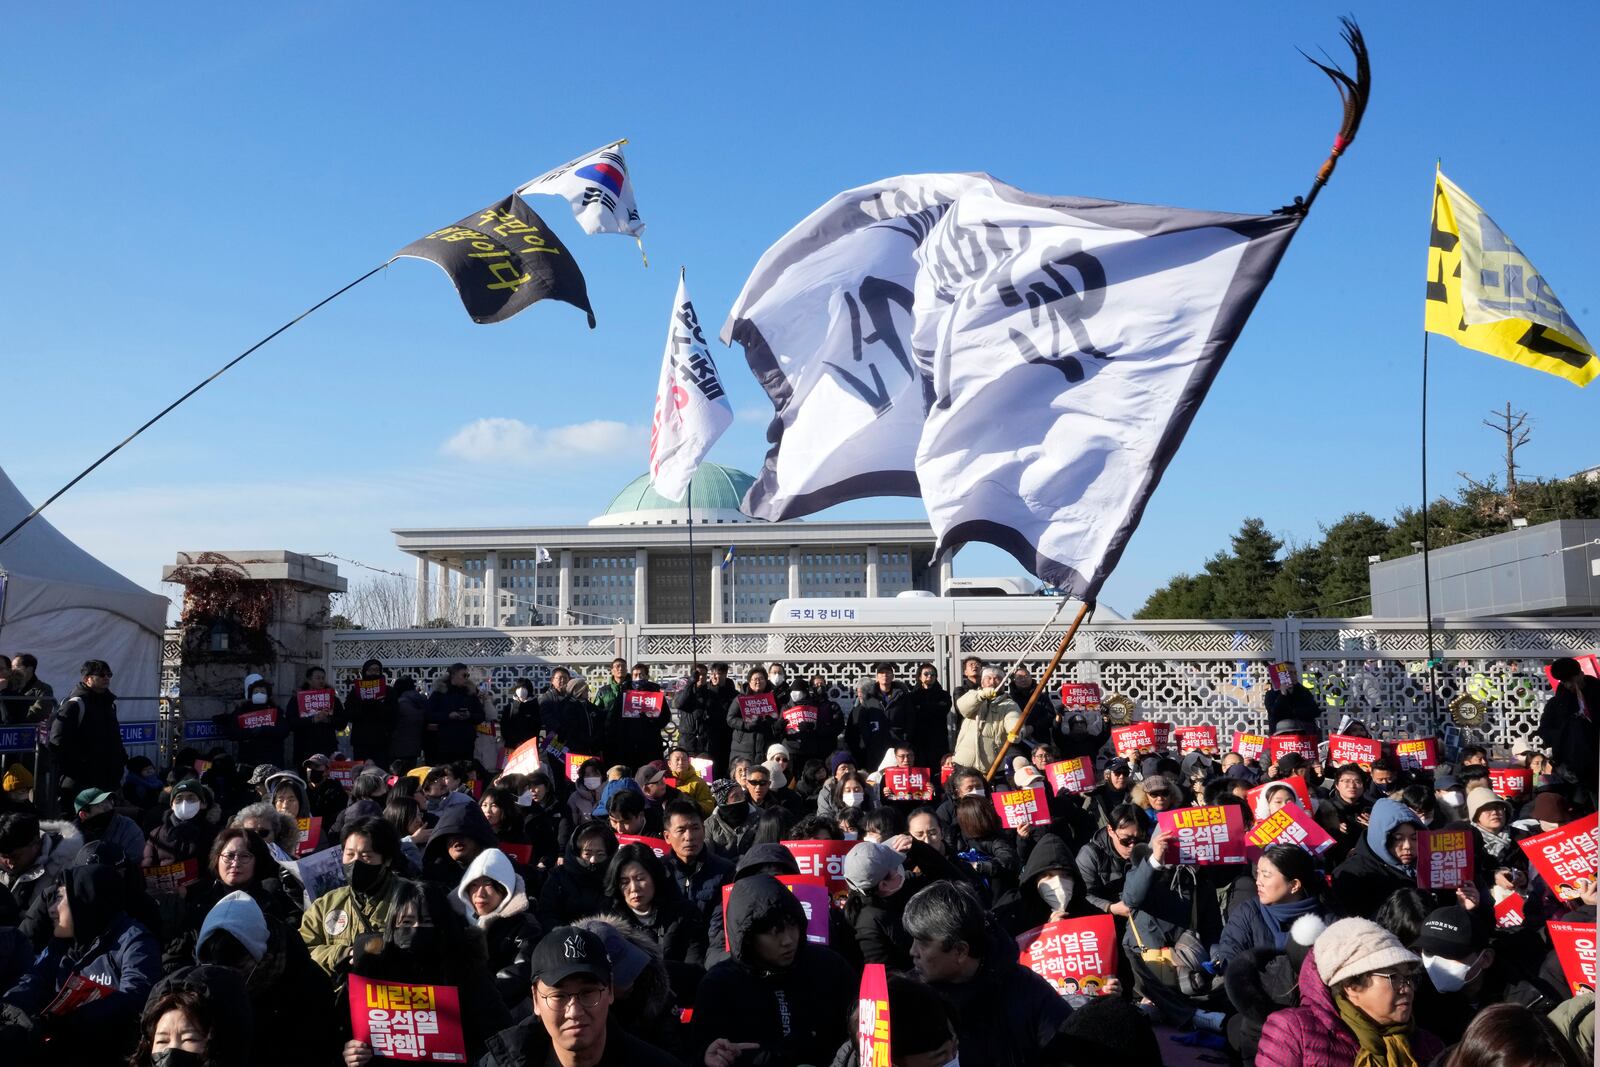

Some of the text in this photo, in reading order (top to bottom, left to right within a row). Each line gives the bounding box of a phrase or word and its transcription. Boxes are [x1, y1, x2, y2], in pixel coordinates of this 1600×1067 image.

[790, 609, 855, 620] 국회경비대
[304, 694, 331, 702] 윤석열을
[631, 695, 658, 710] 탄핵
[1066, 696, 1086, 704] 윤석열
[744, 706, 761, 715] 윤석열
[1460, 706, 1476, 716] 국회
[126, 727, 144, 740] LINE
[195, 723, 219, 738] POLICE
[1118, 729, 1146, 741] 내란수괴
[1182, 731, 1210, 740] 내란수괴
[1117, 737, 1153, 751] 윤석열 체포
[1181, 739, 1200, 748] 윤석열
[1240, 734, 1265, 745] 내란죄
[1280, 741, 1311, 751] 내란수괴
[1338, 741, 1373, 754] 내란수괴
[1397, 741, 1425, 753] 내란죄
[1301, 750, 1316, 760] 체포
[1333, 749, 1376, 763] 윤석열 체포
[1053, 758, 1082, 775] 내란죄
[893, 774, 923, 791] 탄핵
[1489, 776, 1525, 793] 탄핵
[1000, 789, 1035, 806] 내란죄
[1003, 801, 1038, 818] 윤석열
[1173, 806, 1227, 829] 내란죄
[1178, 824, 1230, 847] 윤석열
[1249, 809, 1295, 849] 내란죄
[1274, 821, 1308, 847] 석열
[1430, 832, 1466, 852] 내란죄
[1178, 844, 1221, 864] 탄핵!
[1430, 849, 1468, 870] 윤석열
[1430, 866, 1462, 888] 탄핵!
[563, 934, 587, 958] NY
[1030, 931, 1098, 961] 윤석열을
[1031, 952, 1103, 976] 탄핵하라
[366, 983, 436, 1010] 내란죄
[368, 1009, 440, 1034] 윤석열
[370, 1033, 428, 1058] 탄핵!
